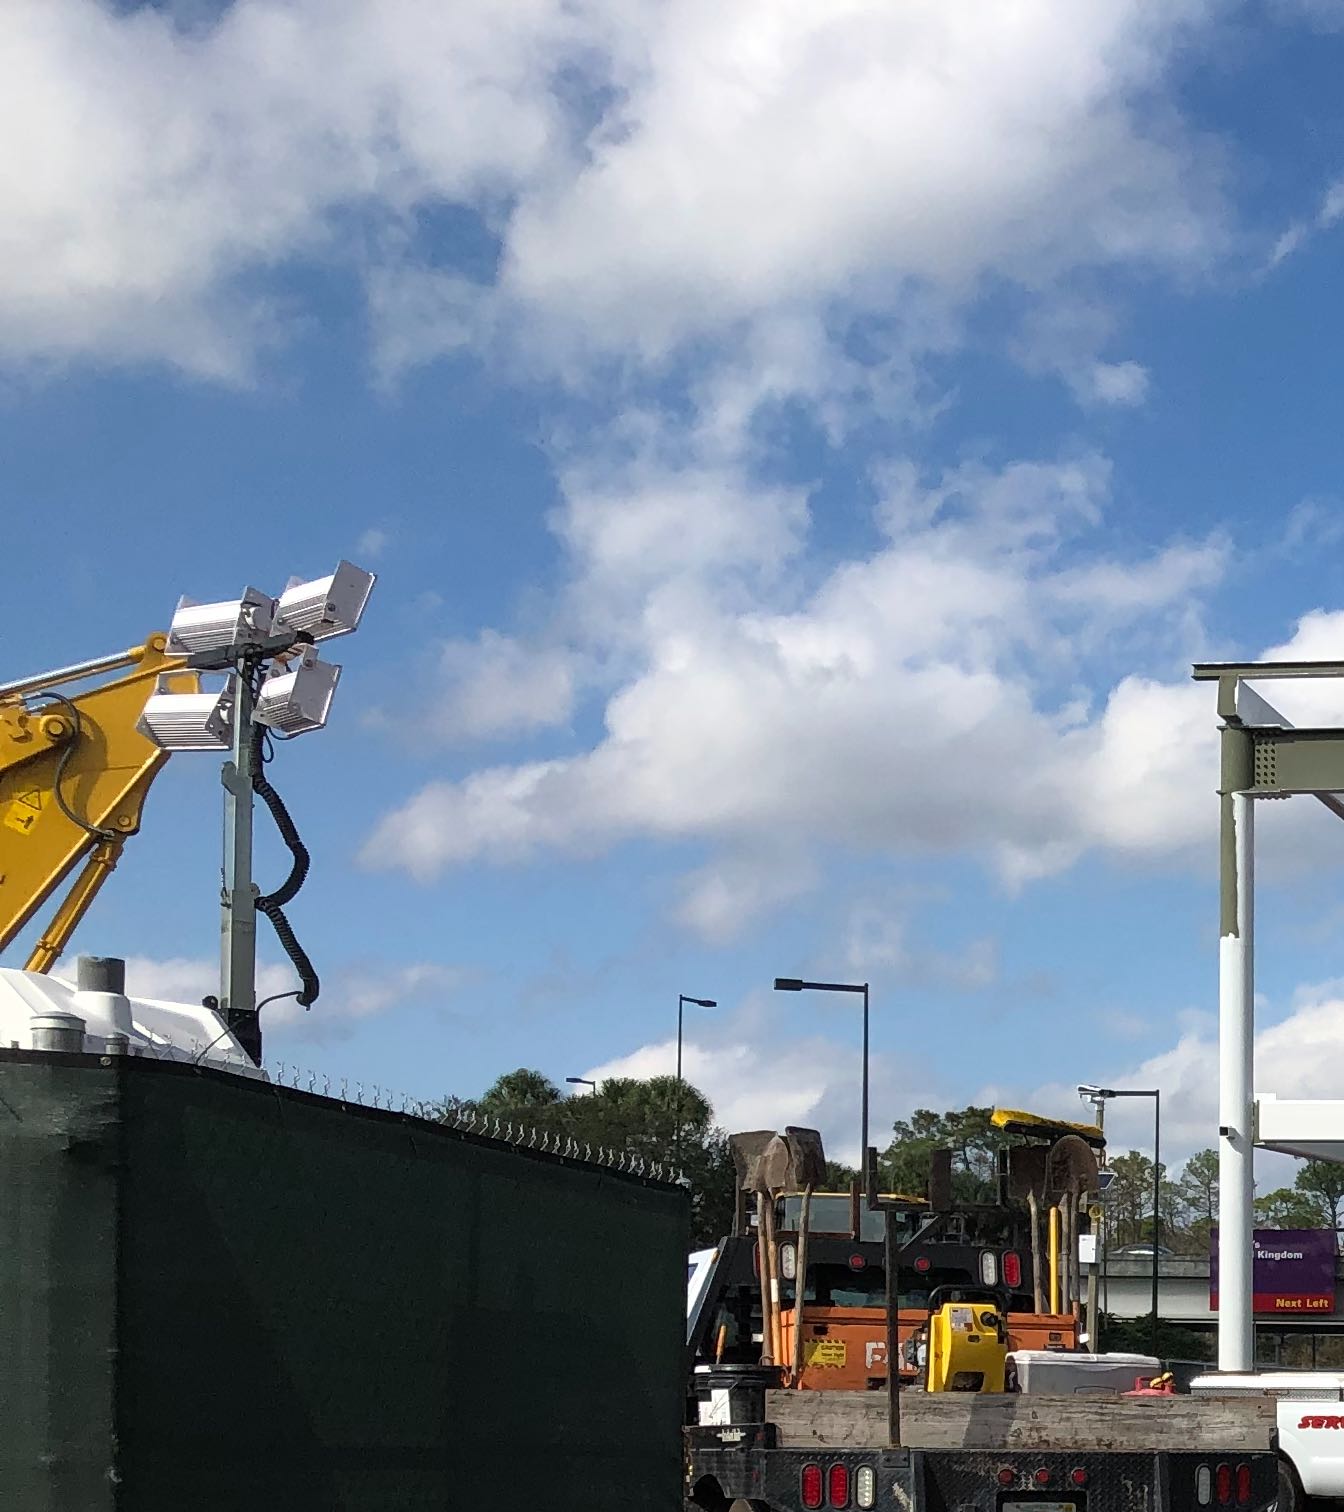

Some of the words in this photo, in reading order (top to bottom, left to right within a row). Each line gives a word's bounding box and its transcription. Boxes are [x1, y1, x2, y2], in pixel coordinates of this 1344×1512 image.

[1257, 1250, 1303, 1261] Kingdom
[1276, 1298, 1302, 1308] Next
[1306, 1298, 1329, 1308] Left
